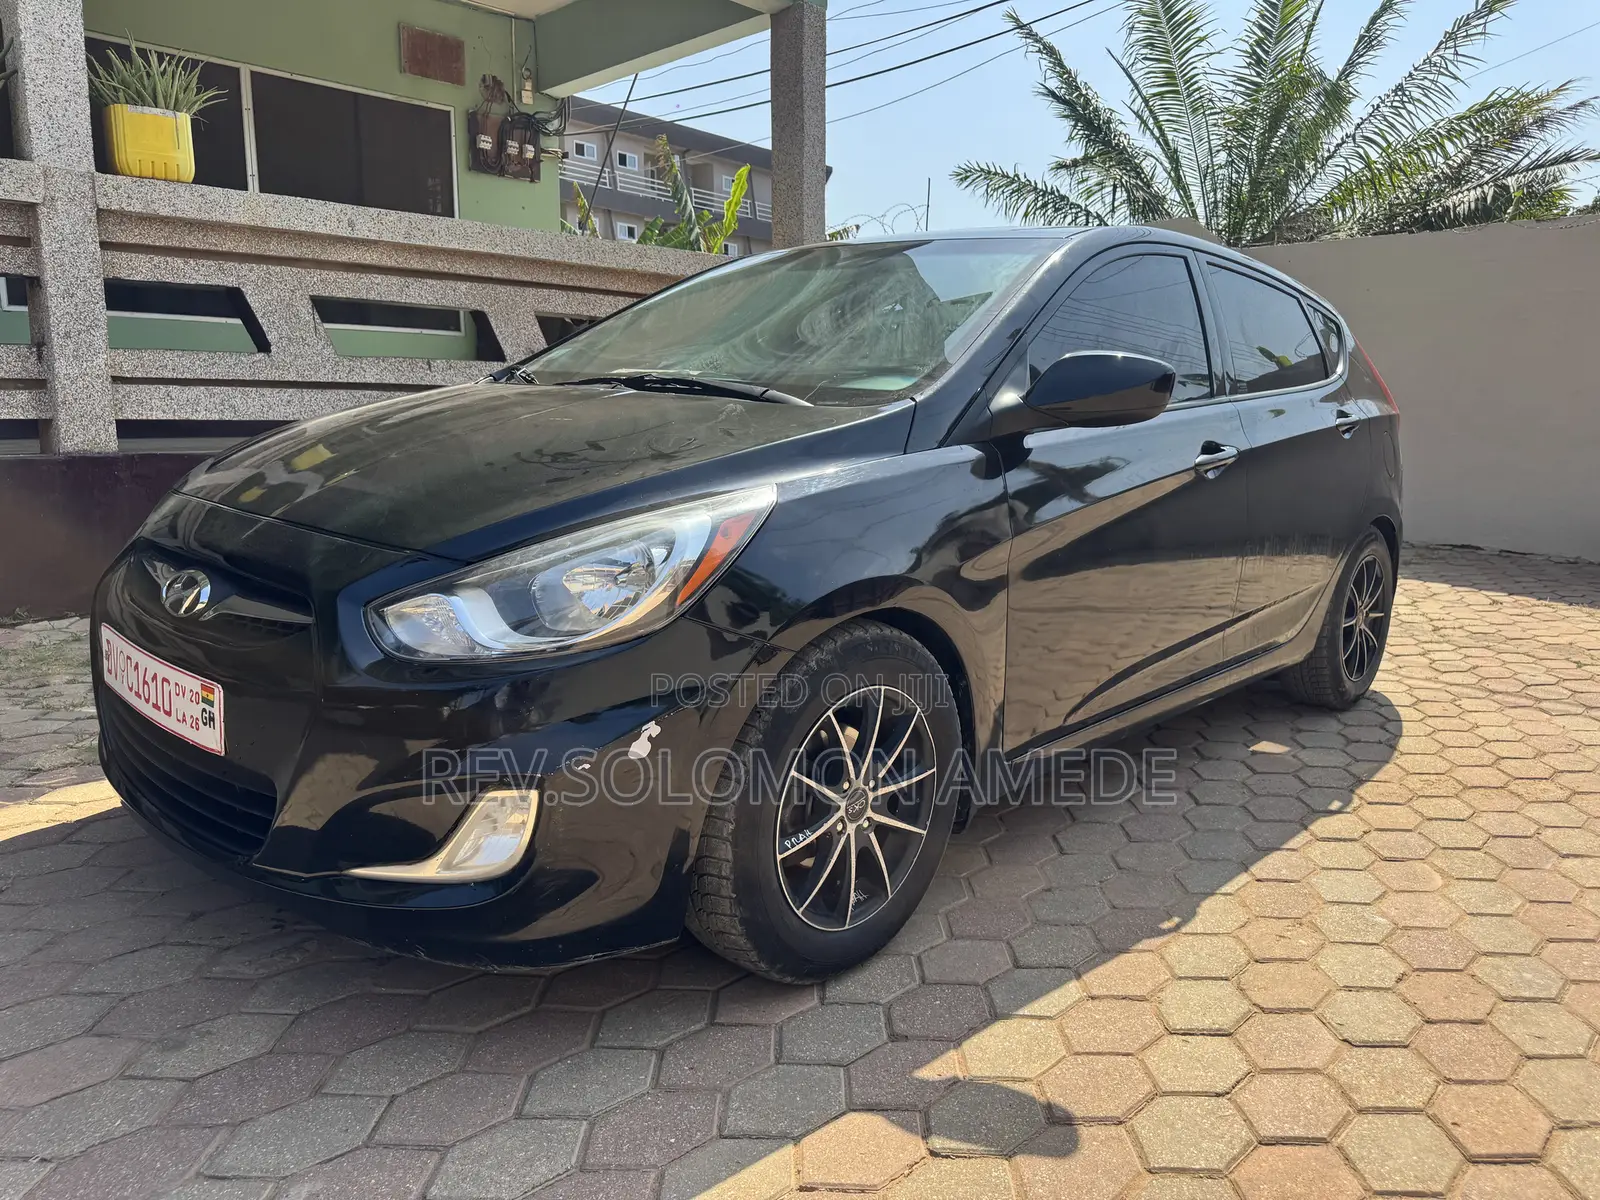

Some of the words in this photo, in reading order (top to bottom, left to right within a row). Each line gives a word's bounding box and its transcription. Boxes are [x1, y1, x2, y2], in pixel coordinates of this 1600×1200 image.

[174, 681, 187, 699] DV
[189, 688, 201, 706] 20
[175, 707, 188, 726] LA
[189, 714, 200, 732] 26
[200, 707, 216, 731] GH
